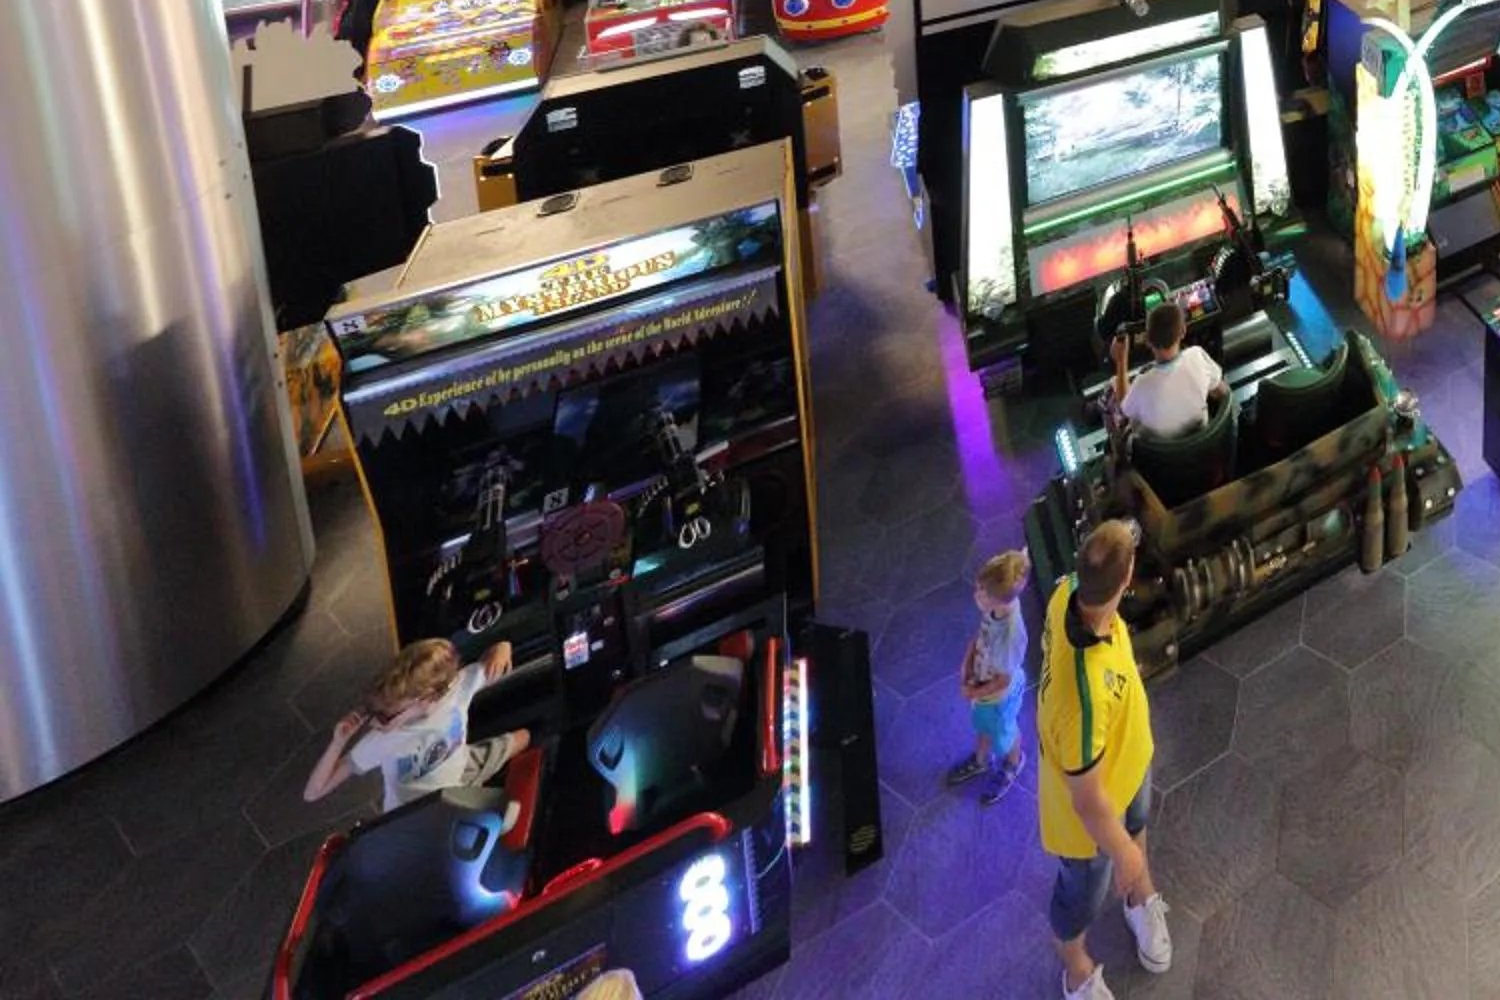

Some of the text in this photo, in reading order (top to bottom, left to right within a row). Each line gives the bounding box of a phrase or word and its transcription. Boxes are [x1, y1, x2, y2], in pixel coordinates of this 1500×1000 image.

[383, 398, 418, 416] 4D
[418, 376, 484, 408] Experience
[512, 350, 572, 381] personally
[587, 339, 603, 354] the
